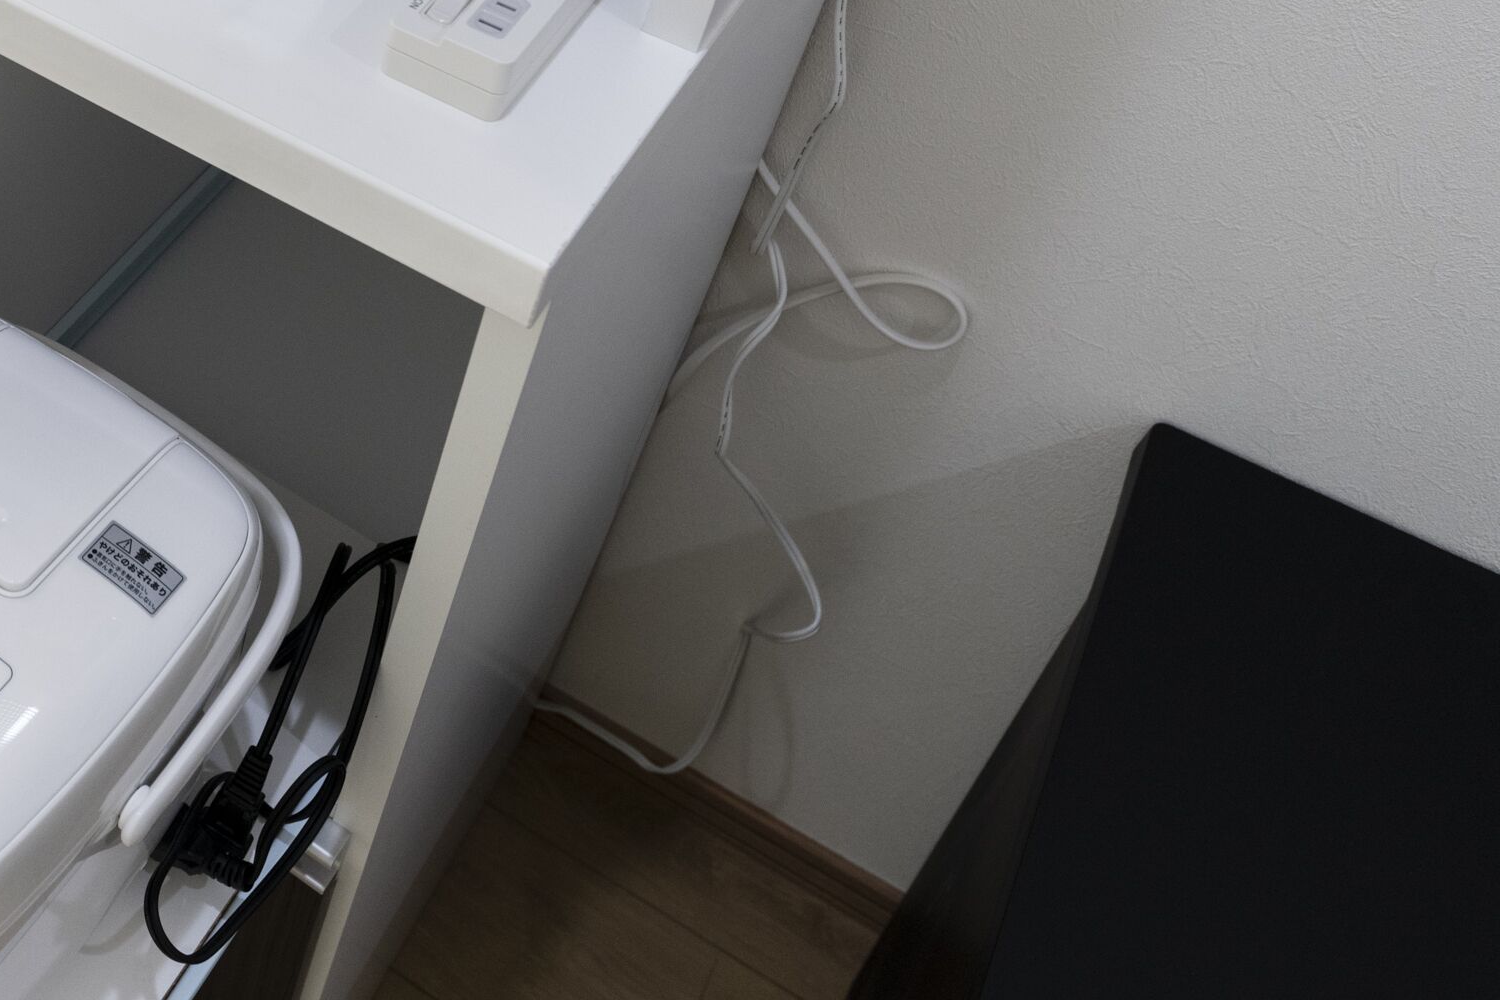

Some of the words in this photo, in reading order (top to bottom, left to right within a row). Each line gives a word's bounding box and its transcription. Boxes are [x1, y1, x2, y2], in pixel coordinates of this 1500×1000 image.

[99, 541, 167, 596] やけどのおそれあり
[134, 547, 169, 578] 警告
